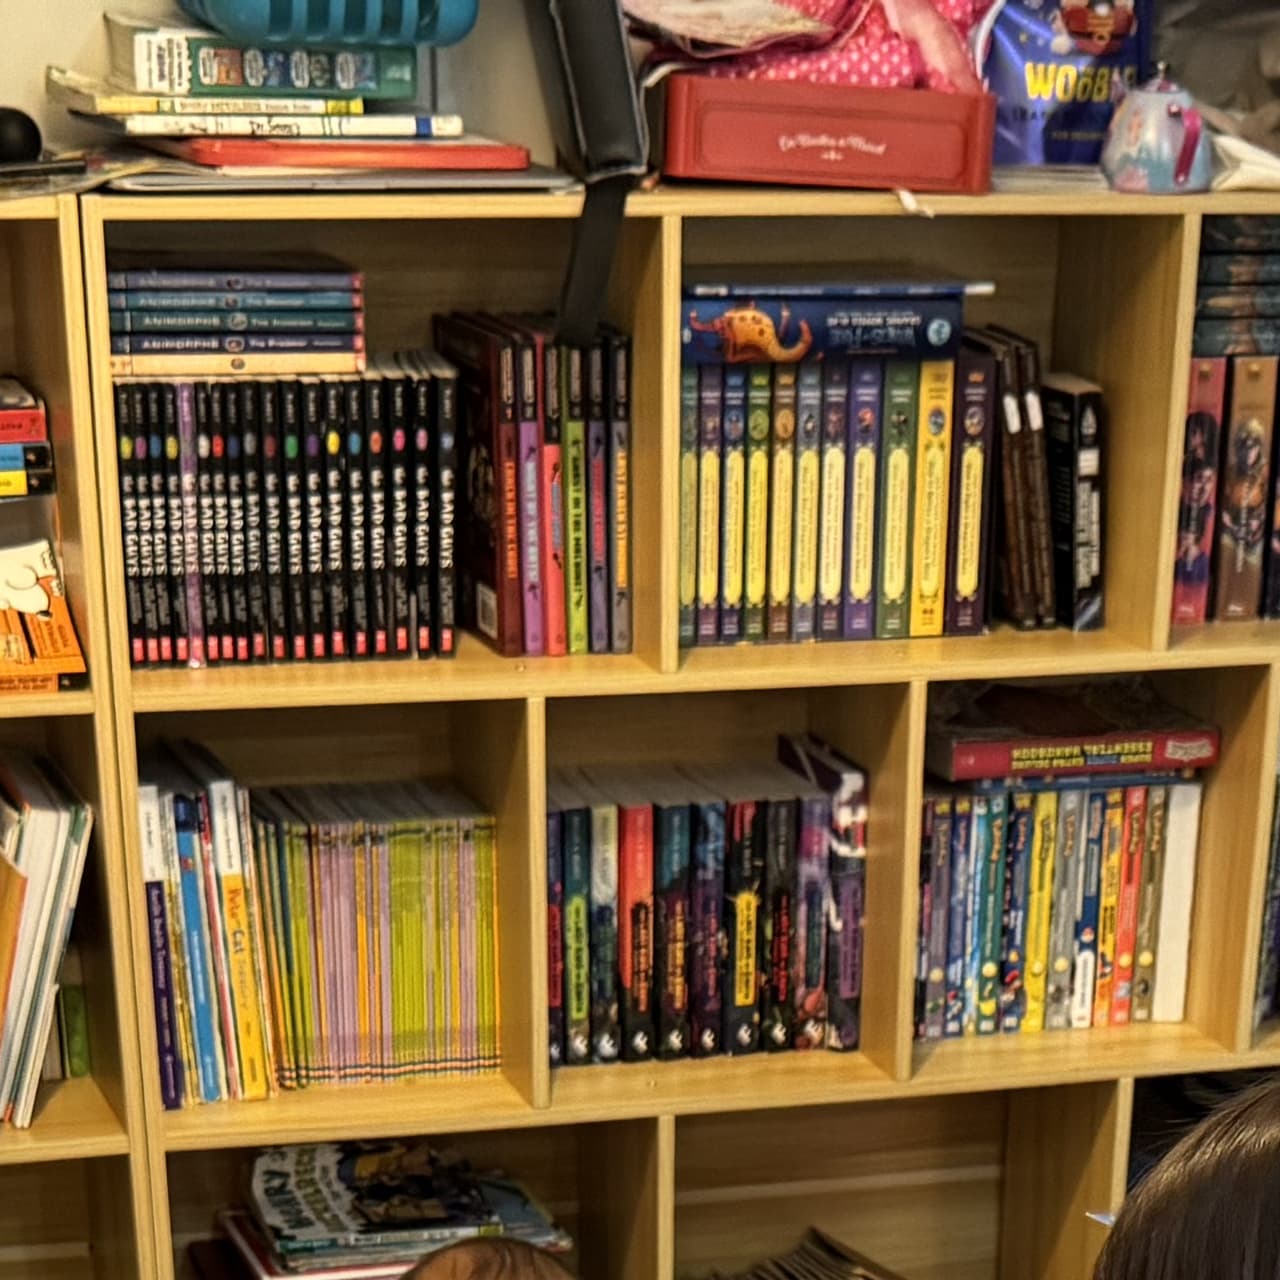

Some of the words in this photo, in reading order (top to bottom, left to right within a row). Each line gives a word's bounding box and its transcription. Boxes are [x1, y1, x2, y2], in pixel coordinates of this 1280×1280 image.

[183, 496, 198, 530] BAD
[200, 498, 214, 531] BAD
[215, 497, 229, 530] BAD
[230, 498, 244, 531] BAD
[247, 494, 260, 527] BAD
[268, 496, 281, 528] BAD
[288, 496, 302, 529] BAD
[308, 495, 322, 529] BAD
[328, 492, 342, 526] BAD
[351, 493, 365, 526] BAD
[372, 492, 385, 525] BAD
[394, 489, 407, 522] BAD
[417, 489, 430, 522] BAD
[441, 491, 454, 524] BAD
[184, 531, 199, 575] GUYS
[201, 532, 216, 576] GUYS
[216, 531, 230, 575] GUYS
[231, 532, 246, 576] GUYS
[247, 529, 262, 572] GUYS
[268, 530, 281, 574] GUYS
[289, 531, 303, 575] GUYS
[309, 530, 323, 574] GUYS
[329, 527, 343, 570] GUYS
[351, 528, 365, 571] GUYS
[372, 527, 386, 570] GUYS
[393, 524, 408, 567] GUYS
[416, 523, 430, 567] GUYS
[440, 526, 454, 569] GUYS
[231, 928, 248, 955] Cat
